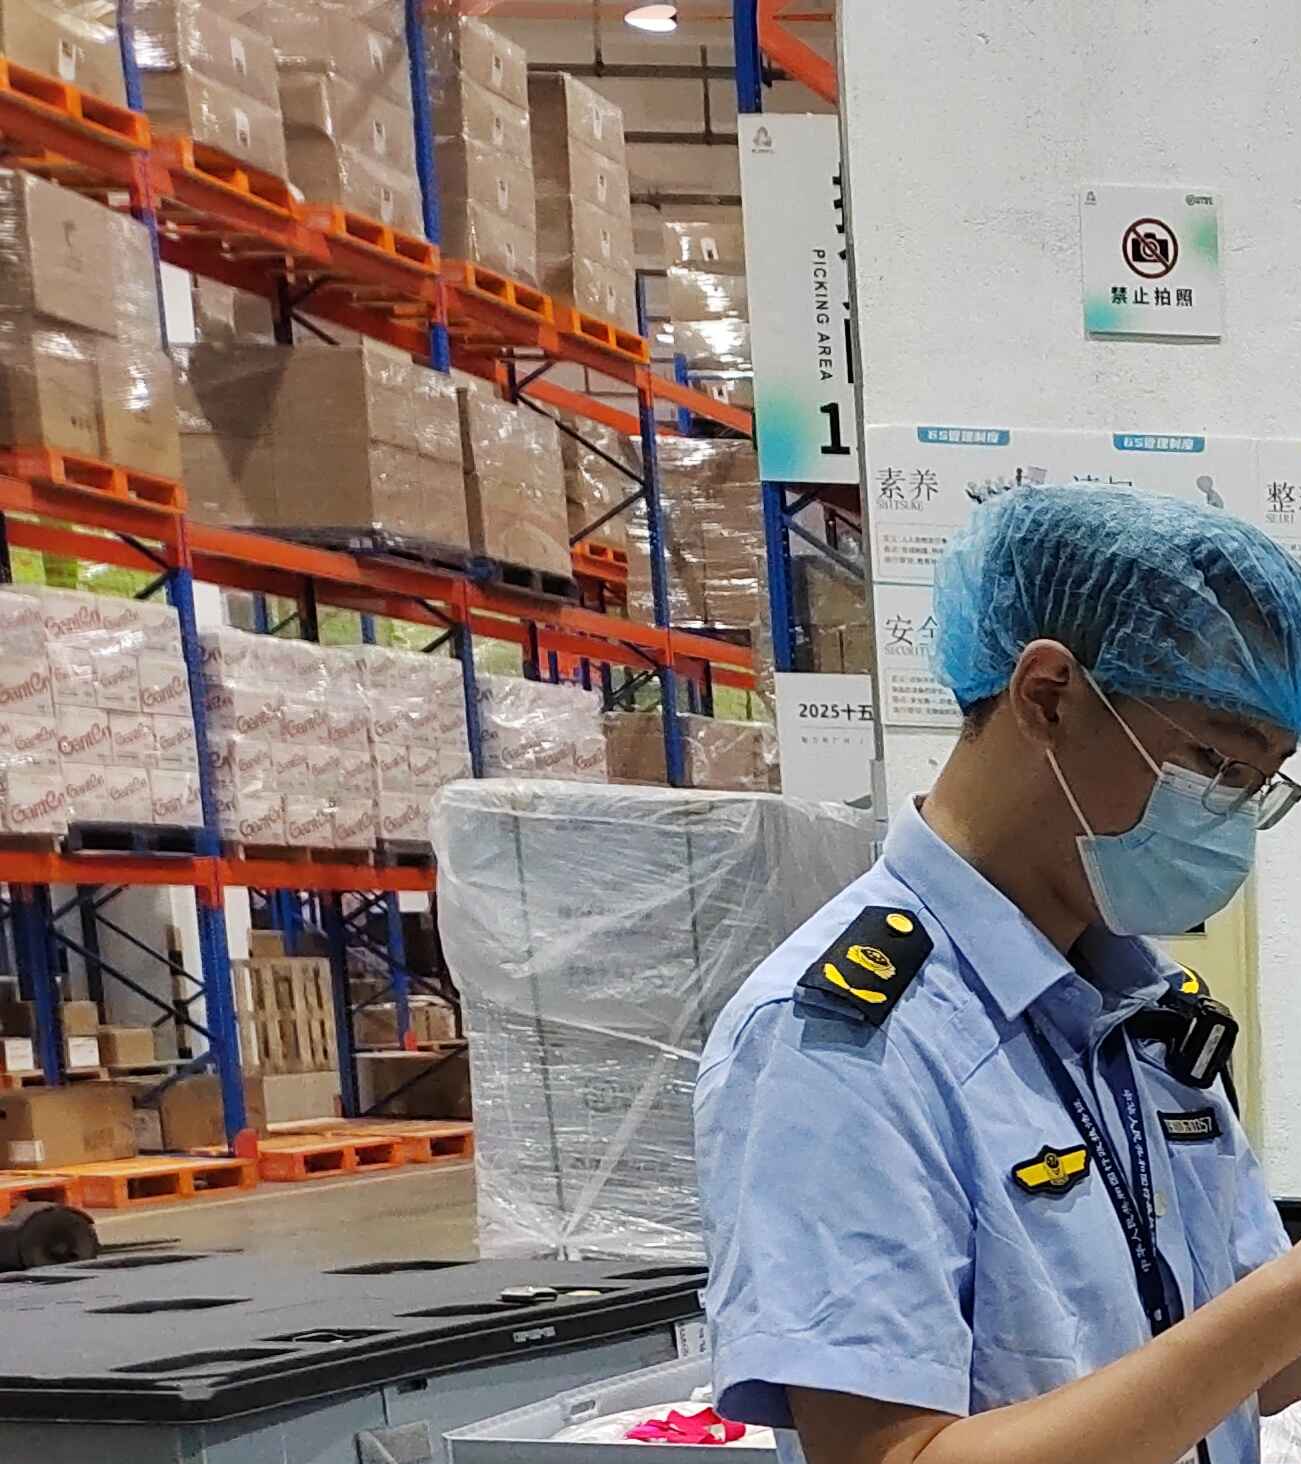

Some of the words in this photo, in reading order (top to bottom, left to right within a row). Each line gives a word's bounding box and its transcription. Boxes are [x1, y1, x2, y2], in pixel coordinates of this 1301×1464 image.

[812, 249, 830, 325] PICKING
[1111, 286, 1193, 307] 禁止拍照
[816, 331, 834, 382] AREA
[820, 402, 851, 456] 1
[875, 467, 939, 500] 素养
